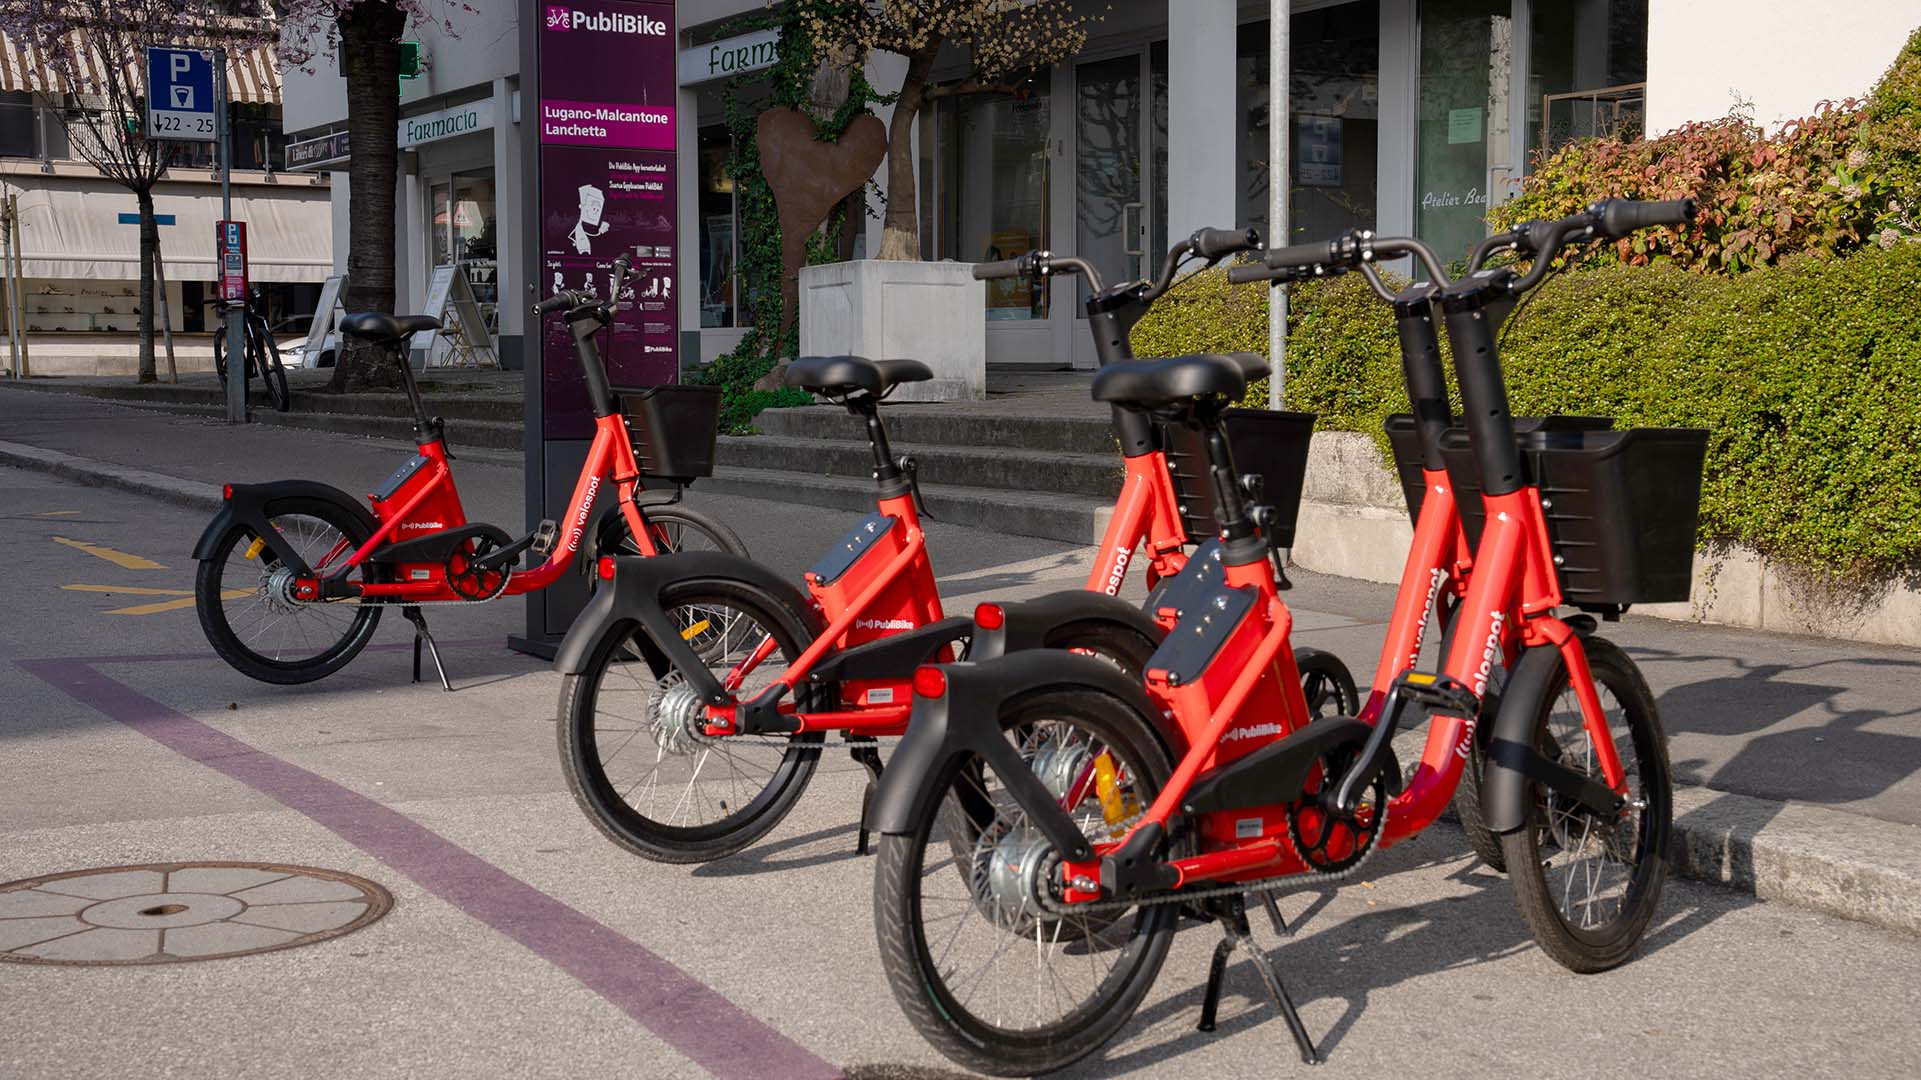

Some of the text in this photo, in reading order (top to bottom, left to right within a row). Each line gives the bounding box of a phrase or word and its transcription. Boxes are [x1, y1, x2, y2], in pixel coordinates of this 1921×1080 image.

[572, 10, 667, 36] PubliBike
[708, 40, 780, 75] farm
[170, 53, 191, 82] P
[544, 105, 668, 124] Lugano-Malcantone
[164, 116, 181, 131] 22
[196, 118, 214, 133] 25
[407, 109, 477, 143] farmacia
[545, 123, 607, 137] Lanchetta
[1422, 191, 1460, 210] Atelier
[228, 223, 237, 235] P
[577, 475, 601, 526] velospot
[1105, 546, 1131, 597] ospot
[874, 619, 914, 630] PubliBike
[1239, 722, 1283, 740] PubliBike
